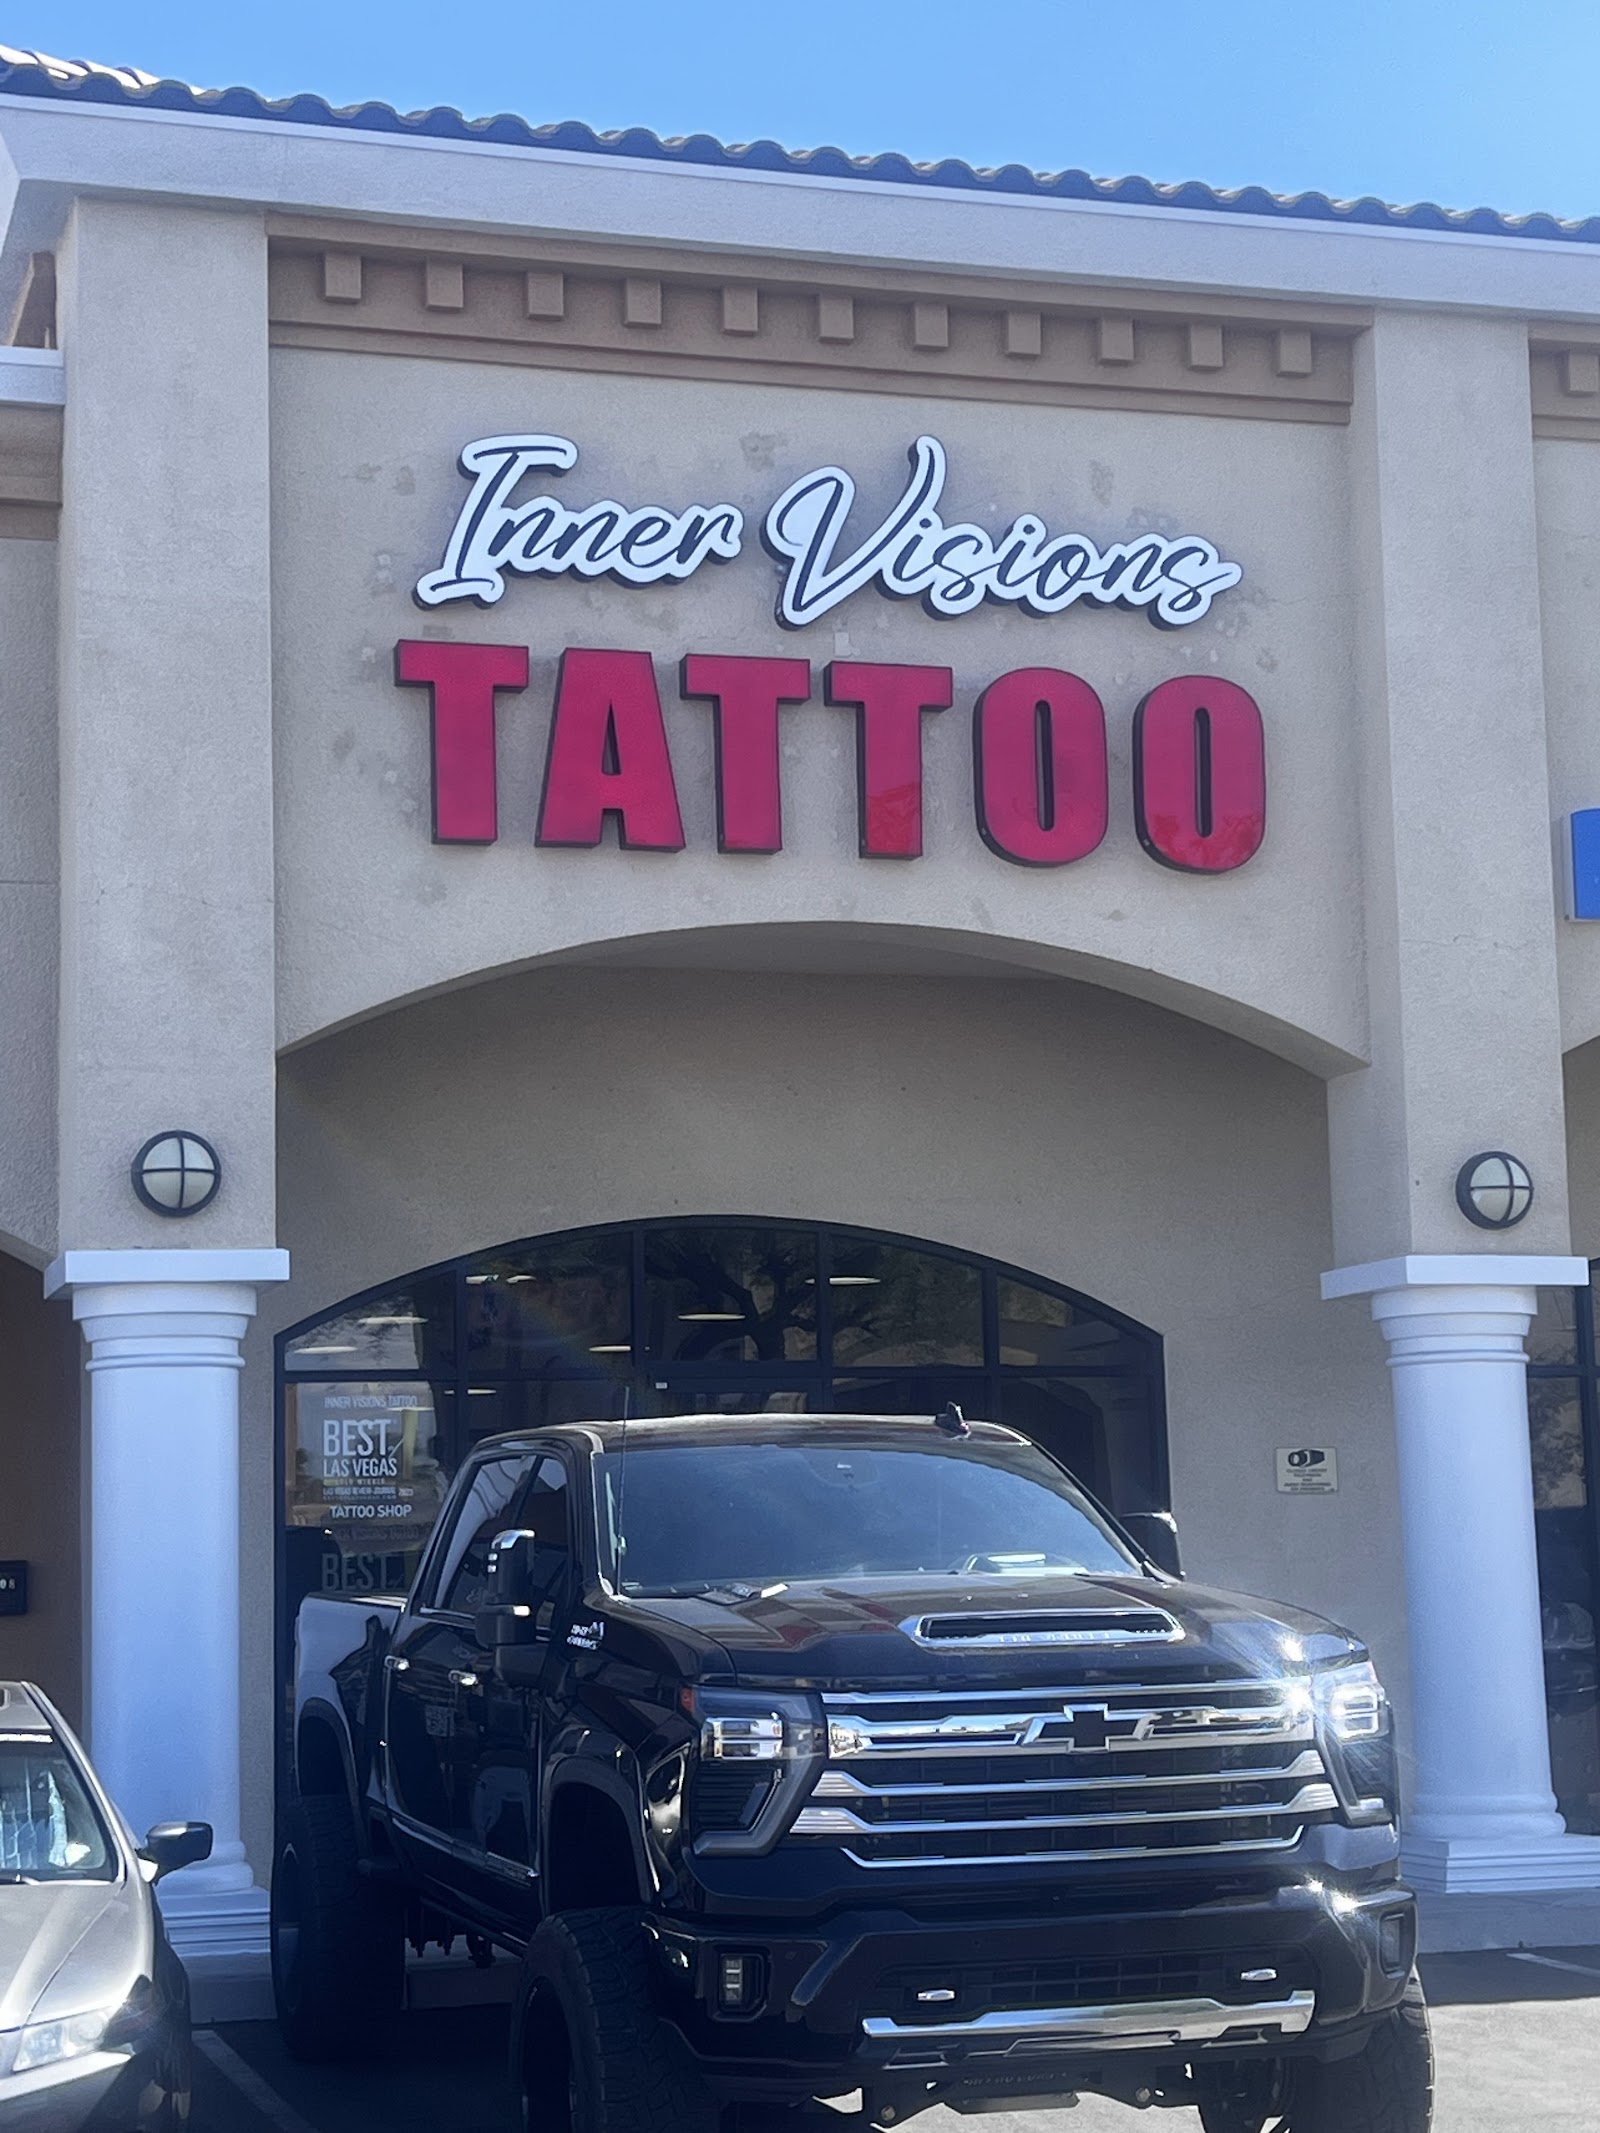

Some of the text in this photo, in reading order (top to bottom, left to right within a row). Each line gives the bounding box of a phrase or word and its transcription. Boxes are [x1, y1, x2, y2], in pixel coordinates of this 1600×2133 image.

[414, 434, 1242, 630] Inner Visions
[394, 640, 1266, 874] TATTOO
[324, 1396, 351, 1409] INNER
[352, 1395, 387, 1408] VISIONS
[323, 1419, 392, 1456] BEST
[323, 1458, 397, 1477] LAS VEGAS
[329, 1504, 412, 1519] TATTOO SHOP
[322, 1552, 390, 1591] BEST
